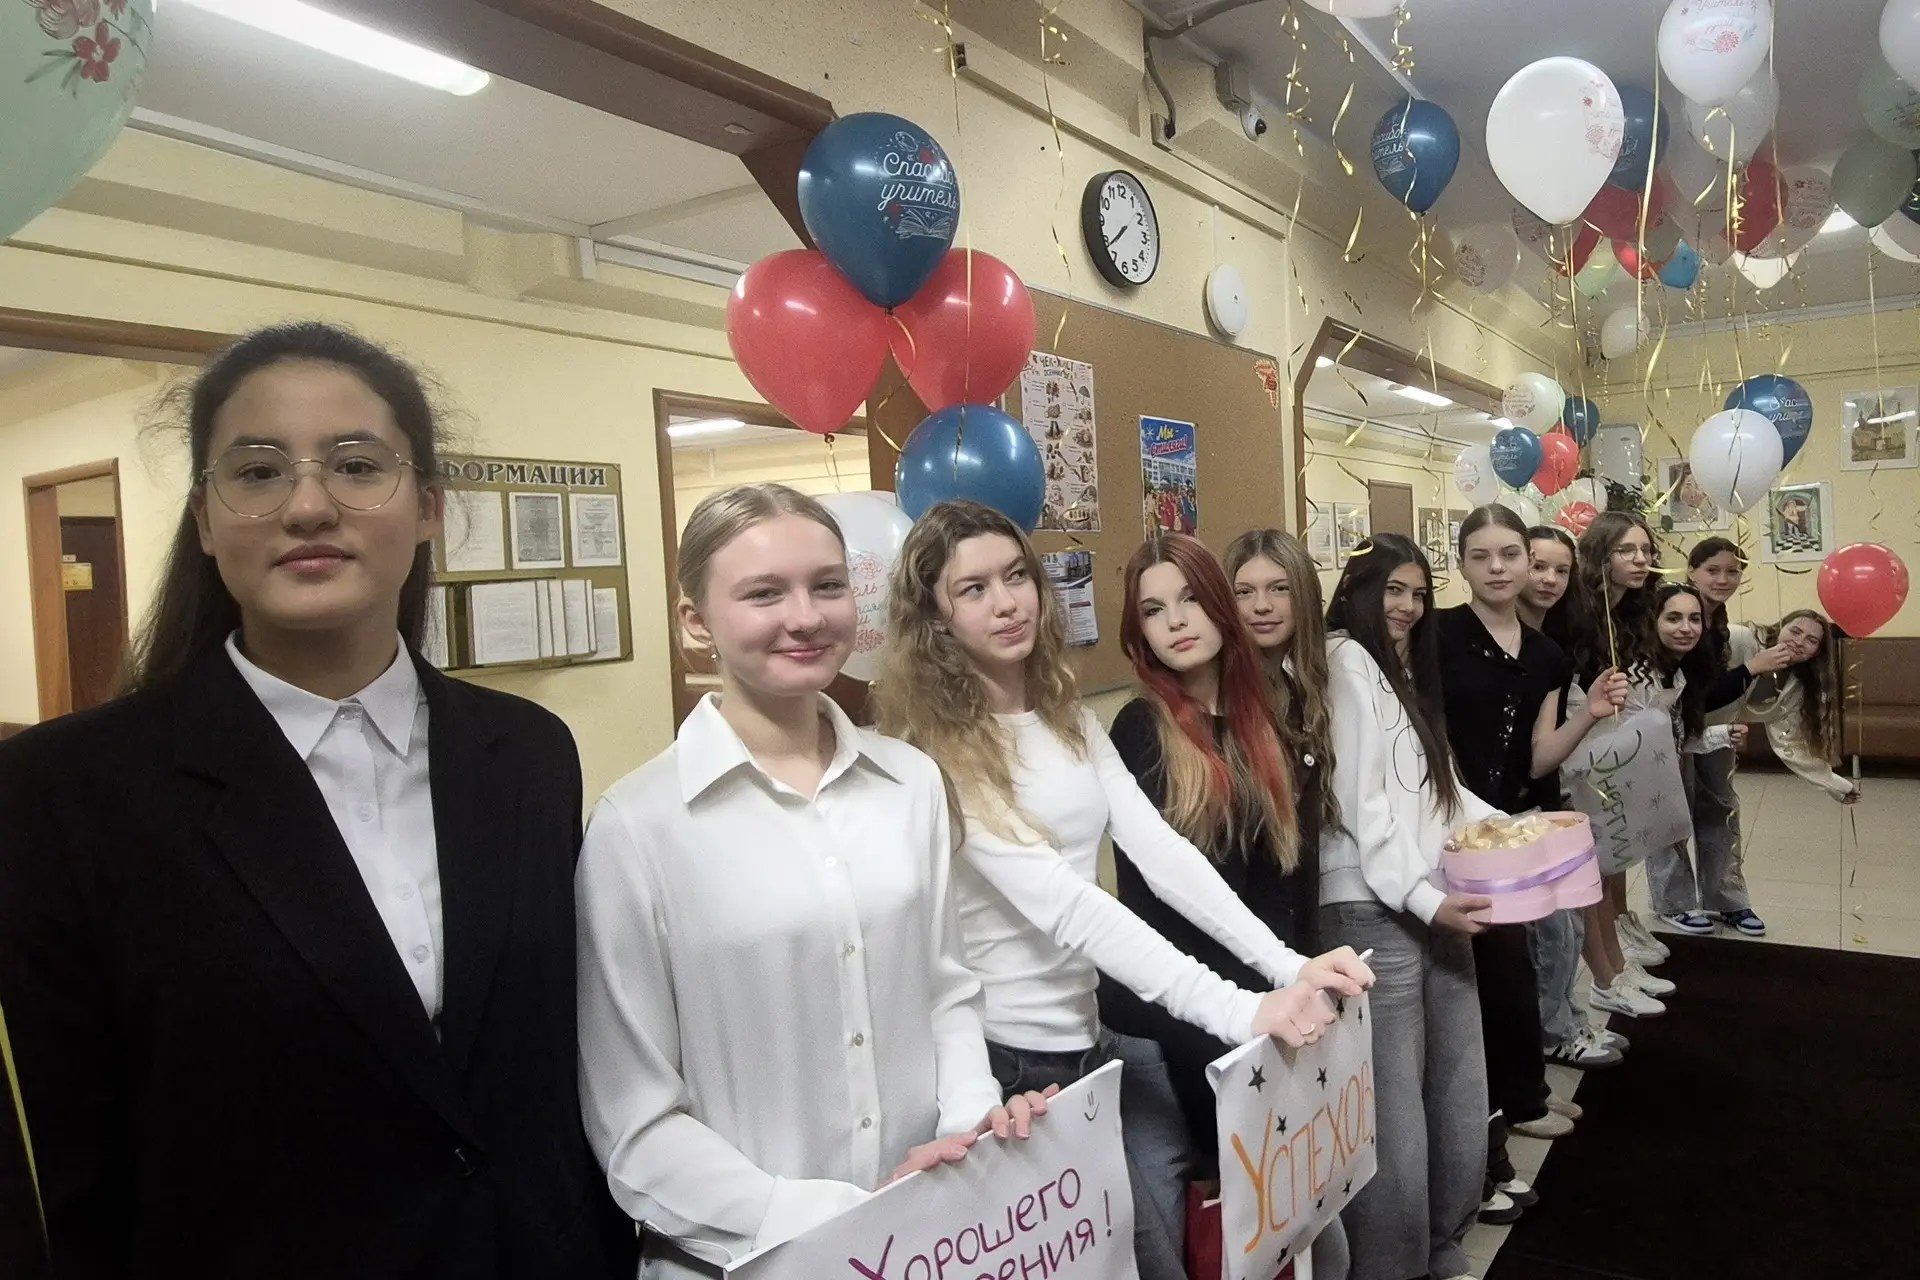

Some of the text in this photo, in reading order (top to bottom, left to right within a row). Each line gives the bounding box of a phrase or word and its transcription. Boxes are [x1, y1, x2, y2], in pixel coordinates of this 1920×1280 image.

[1108, 185, 1116, 199] 11
[1117, 184, 1127, 199] 12
[1101, 195, 1110, 210] 10
[1130, 196, 1135, 208] 1
[1100, 212, 1105, 227] 9
[1136, 212, 1144, 226] 2
[1141, 231, 1148, 245] 3
[1111, 250, 1118, 263] 7
[1138, 250, 1145, 262] 4
[1121, 261, 1129, 275] 6
[1132, 259, 1138, 272] 5
